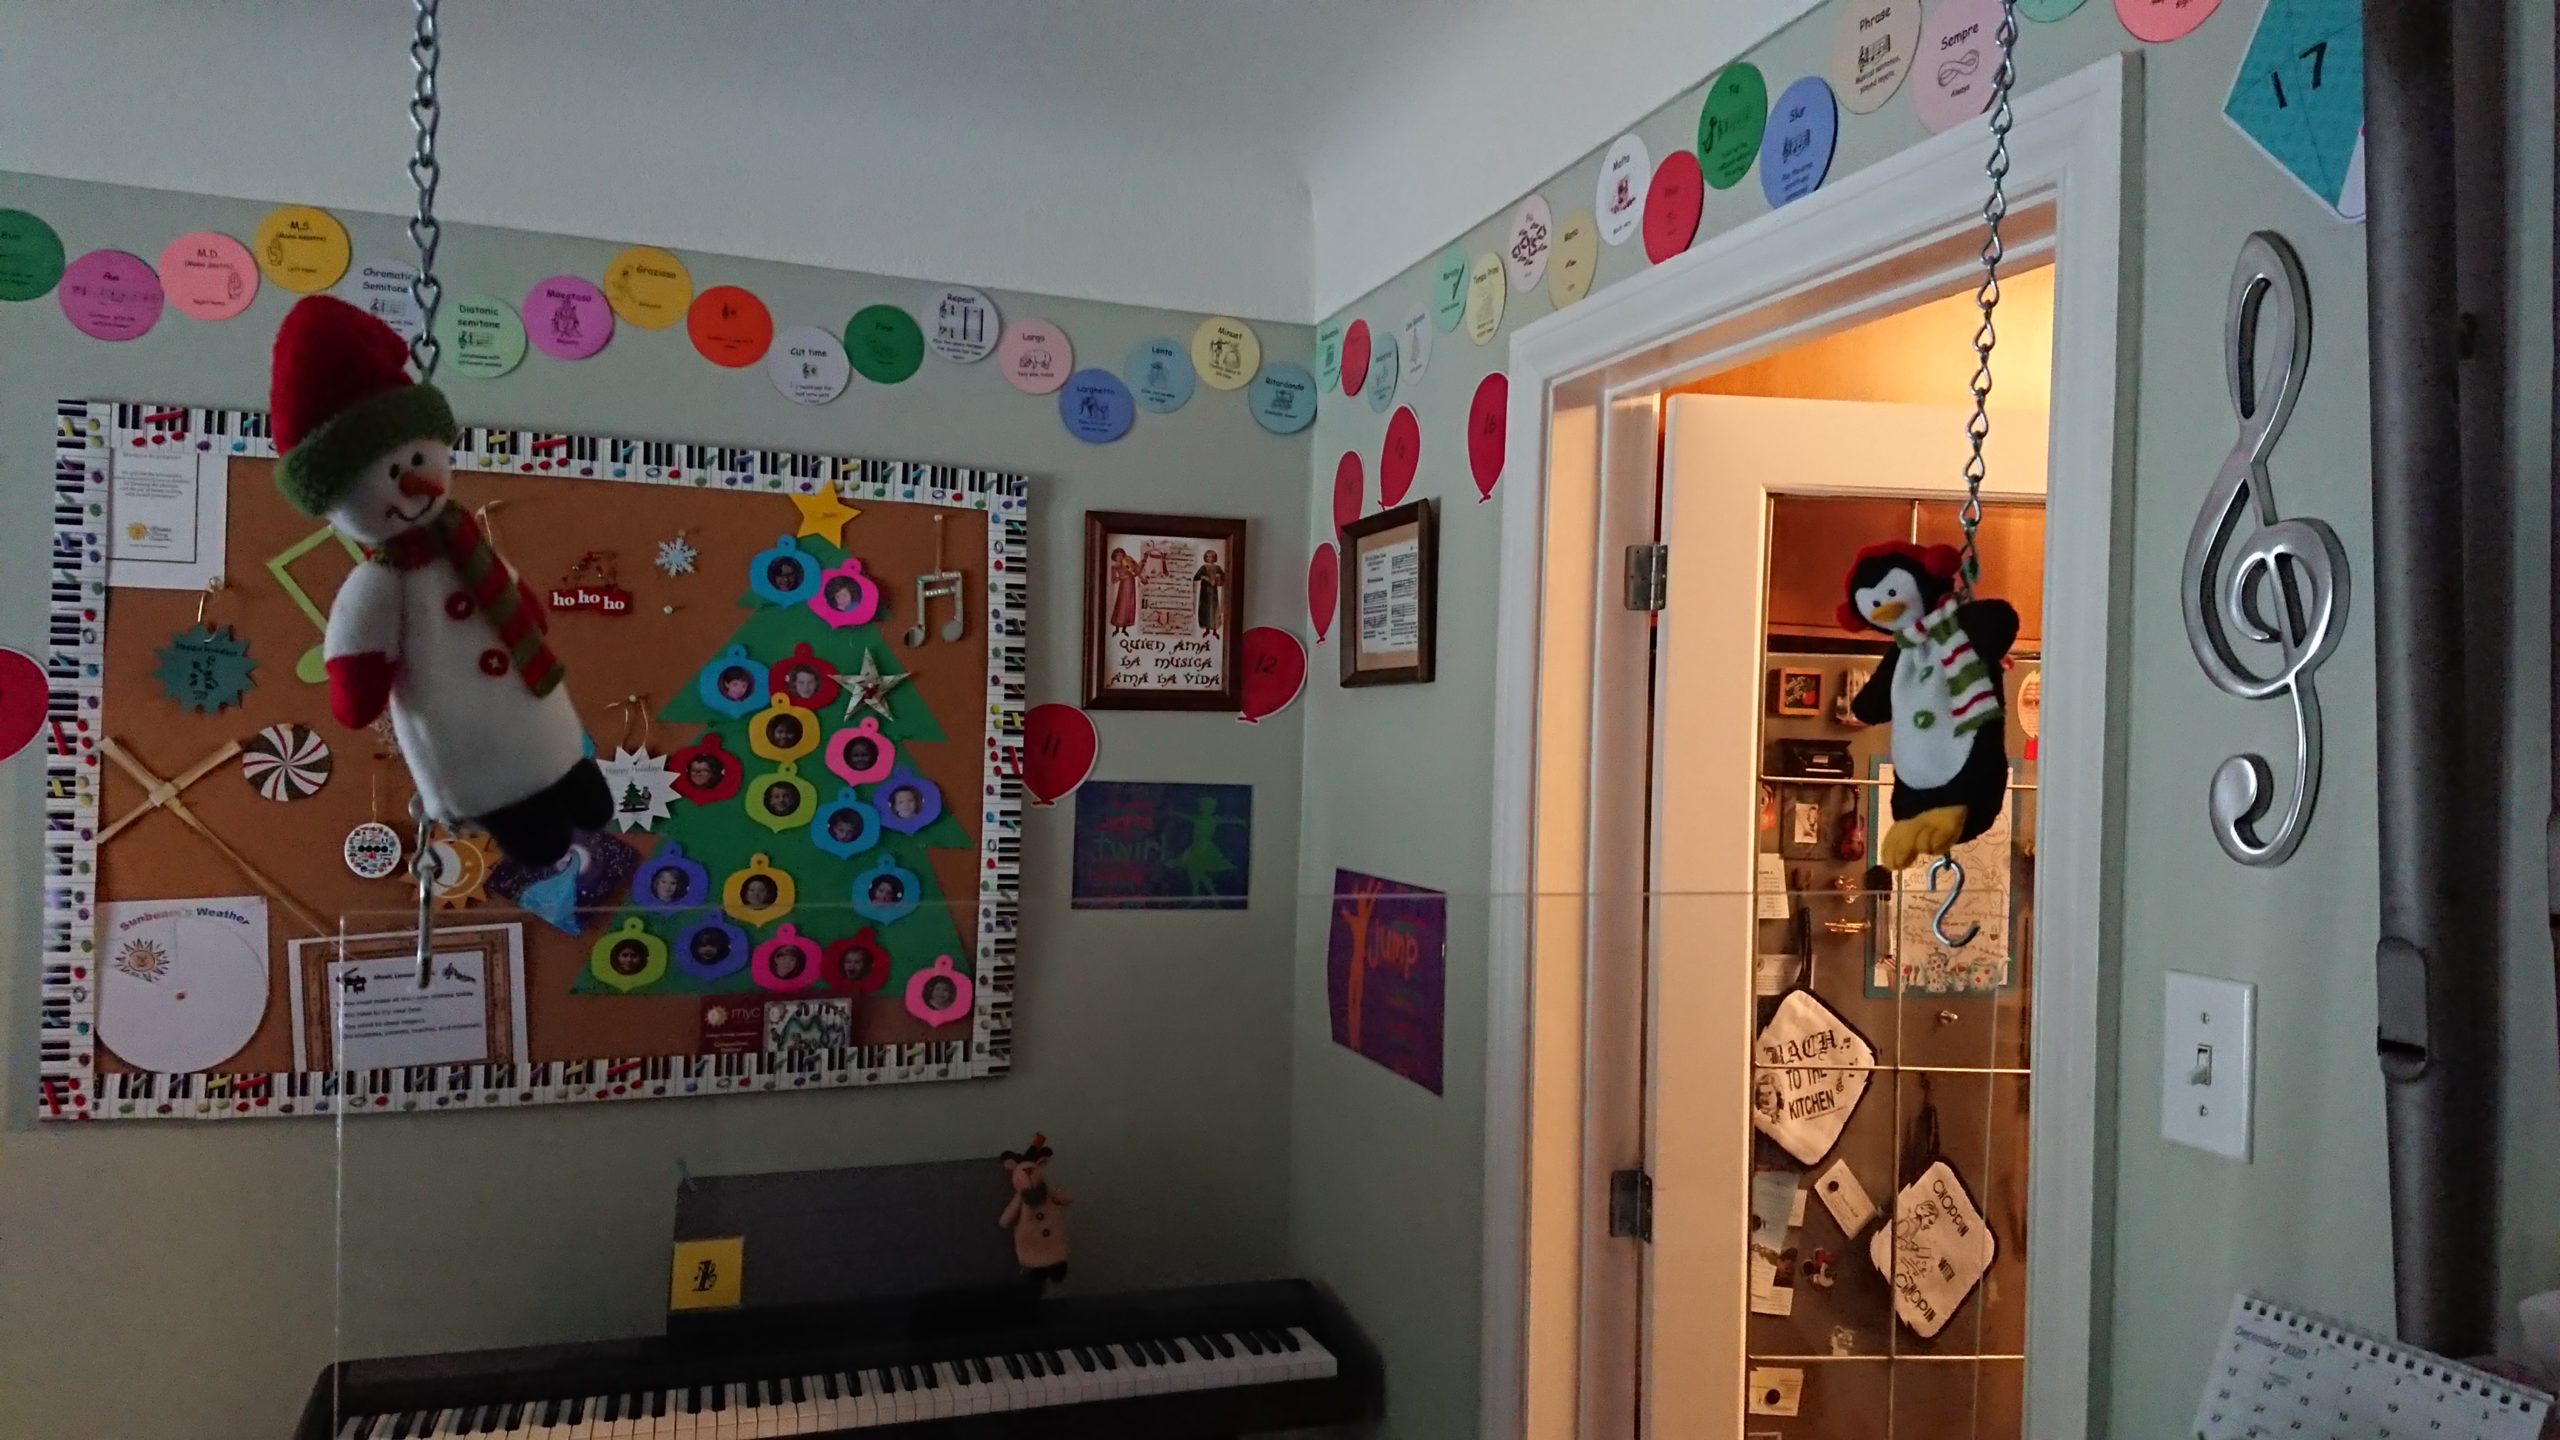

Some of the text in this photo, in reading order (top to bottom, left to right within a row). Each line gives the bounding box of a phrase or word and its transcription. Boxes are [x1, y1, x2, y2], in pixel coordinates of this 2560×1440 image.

[1858, 6, 1892, 31] Phrase
[1940, 22, 1980, 50] Sempre
[2270, 41, 2328, 110] 17
[362, 267, 414, 281] Chromatic
[362, 281, 409, 294] Semitone
[458, 304, 500, 316] Diatonic
[457, 318, 501, 329] semitone
[1021, 332, 1046, 344] Largo
[790, 346, 828, 358] Cut time
[552, 589, 625, 610] ho ho ho
[1168, 639, 1211, 656] AMA
[1254, 653, 1279, 674] 12
[1110, 671, 1149, 687] AMA
[1184, 671, 1221, 688] VIDA
[195, 907, 251, 925] Weather
[1367, 918, 1419, 982] Jump
[731, 1007, 762, 1020] myc
[1763, 1028, 1838, 1066] BACH
[1785, 1067, 1802, 1092] TO
[1787, 1088, 1836, 1121] KITCHEN
[2234, 1325, 2308, 1360] December 2020
